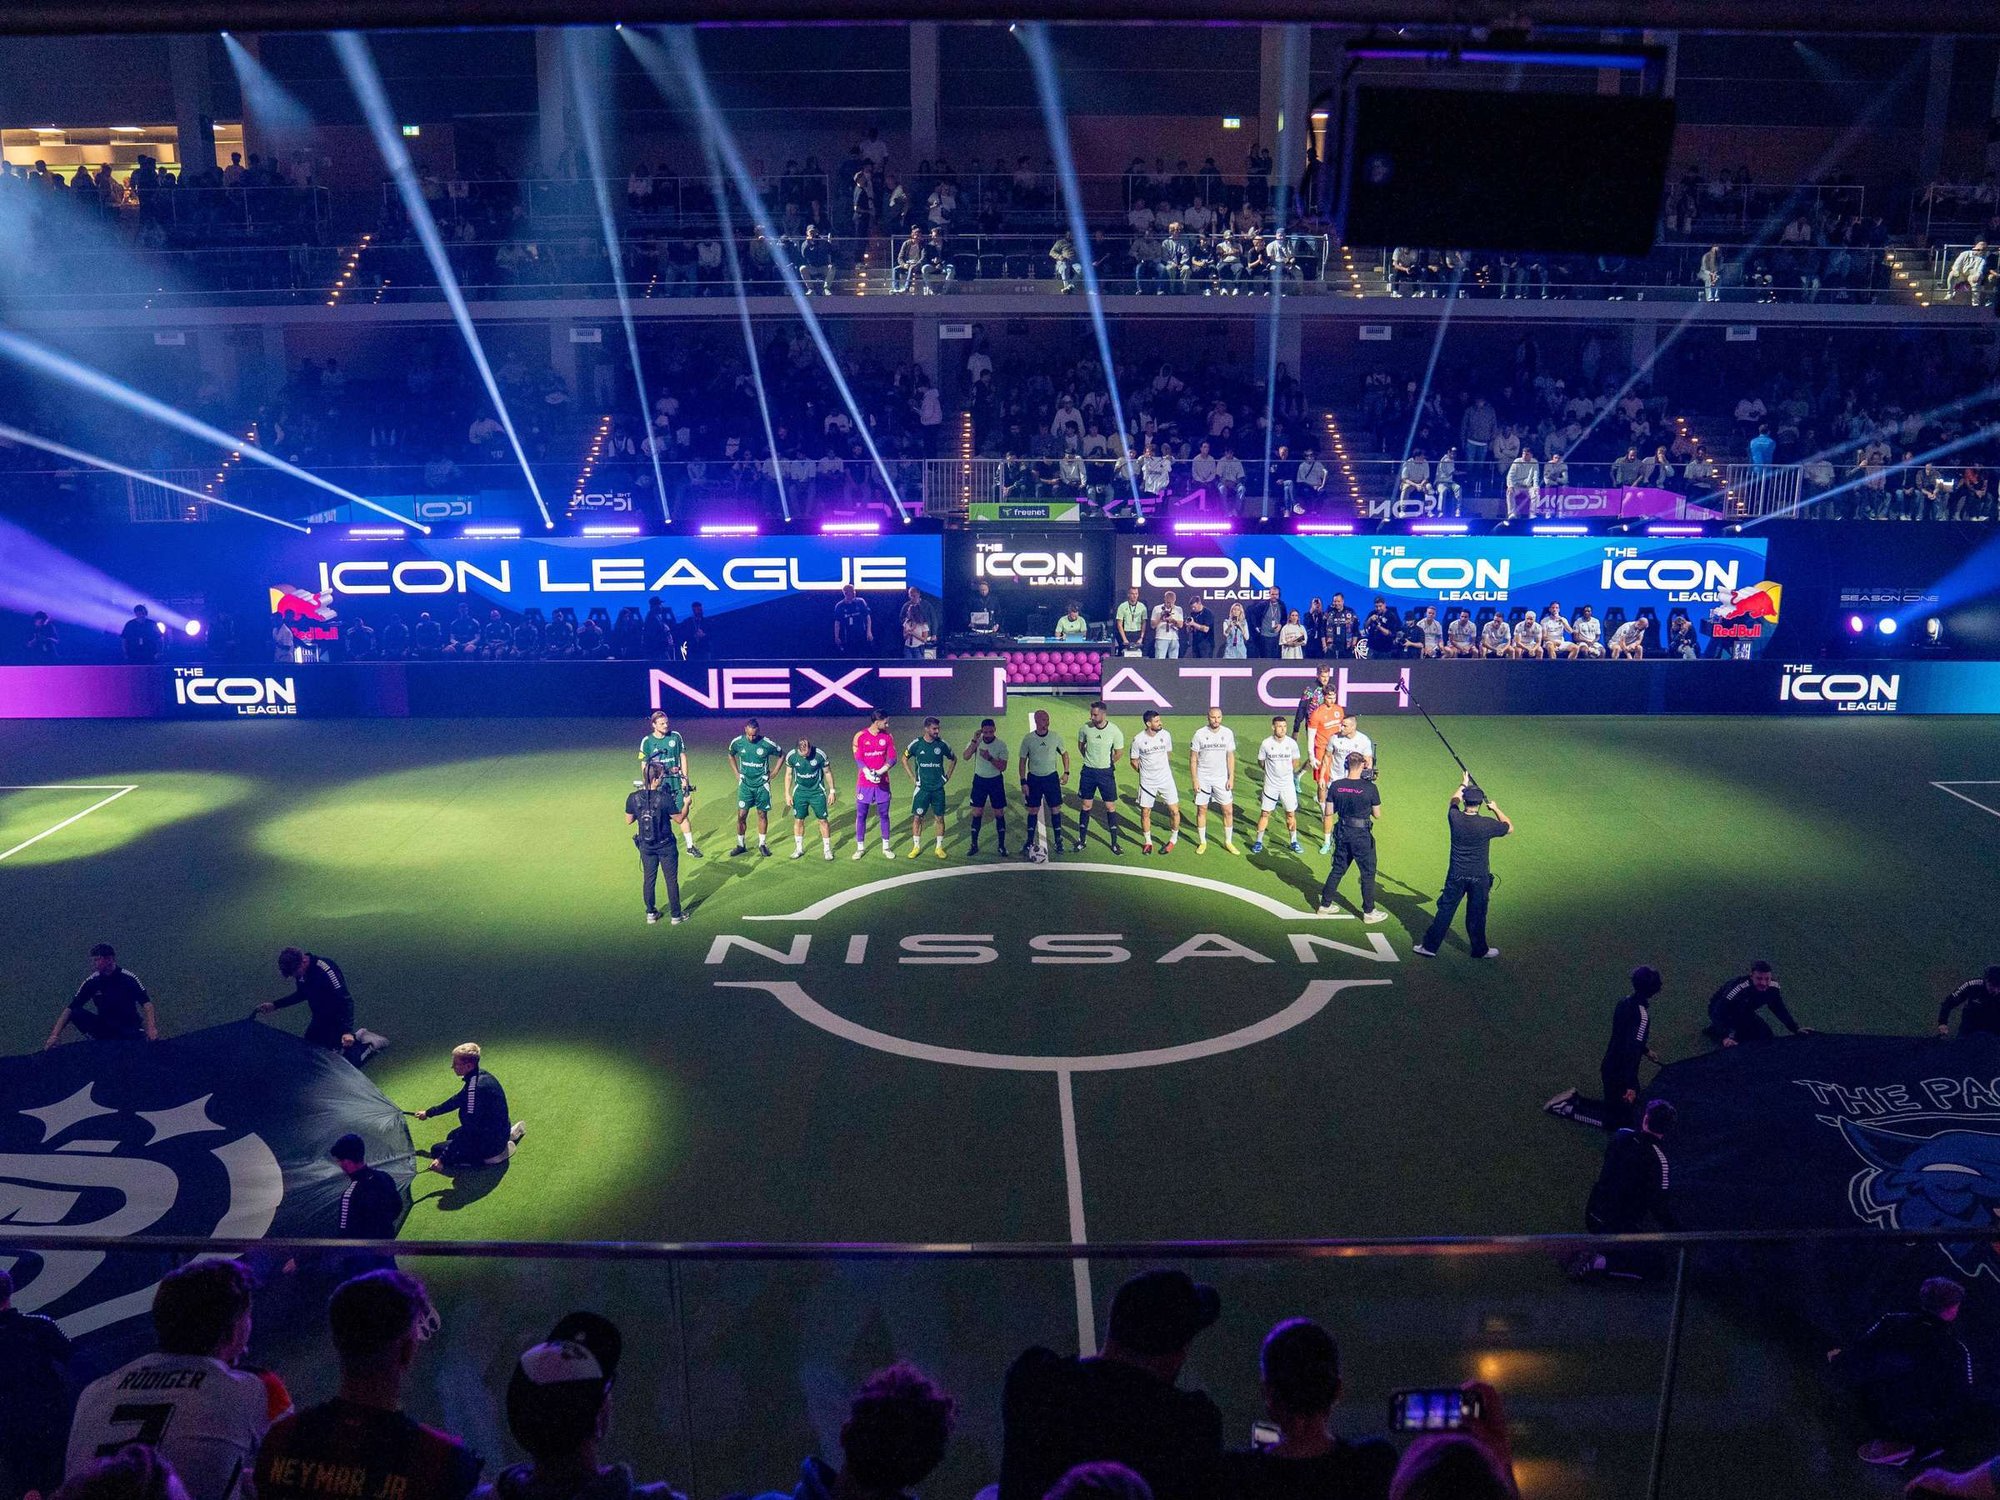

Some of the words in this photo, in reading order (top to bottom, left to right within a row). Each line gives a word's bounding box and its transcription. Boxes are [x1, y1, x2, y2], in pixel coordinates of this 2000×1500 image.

[1014, 508, 1046, 516] freenet
[976, 543, 1003, 552] THE
[1132, 545, 1168, 555] THE
[1371, 546, 1405, 556] THE
[1604, 547, 1638, 557] THE
[976, 552, 1083, 577] ICON
[318, 559, 511, 594] ICON
[538, 557, 907, 592] LEAGUE
[1131, 557, 1275, 588] ICON
[1369, 558, 1510, 590] ICON
[1601, 559, 1739, 590] ICON
[1029, 577, 1083, 585] LEAGUE
[1439, 591, 1508, 601] LEAGUE
[1668, 592, 1720, 602] LEAG
[1840, 594, 1901, 602] SEASON
[1713, 623, 1738, 638] Red
[1737, 623, 1762, 638] Bull
[174, 667, 204, 677] THE
[1783, 664, 1813, 673] THE
[175, 677, 296, 704] ICON
[649, 667, 953, 709] NEXT
[993, 667, 1410, 708] ATCH
[1780, 674, 1900, 700] ICON
[237, 705, 297, 714] LEAGUE
[1838, 701, 1897, 711] LEAGUE
[704, 933, 1400, 965] NISSAN
[1792, 1079, 1922, 1115] THE
